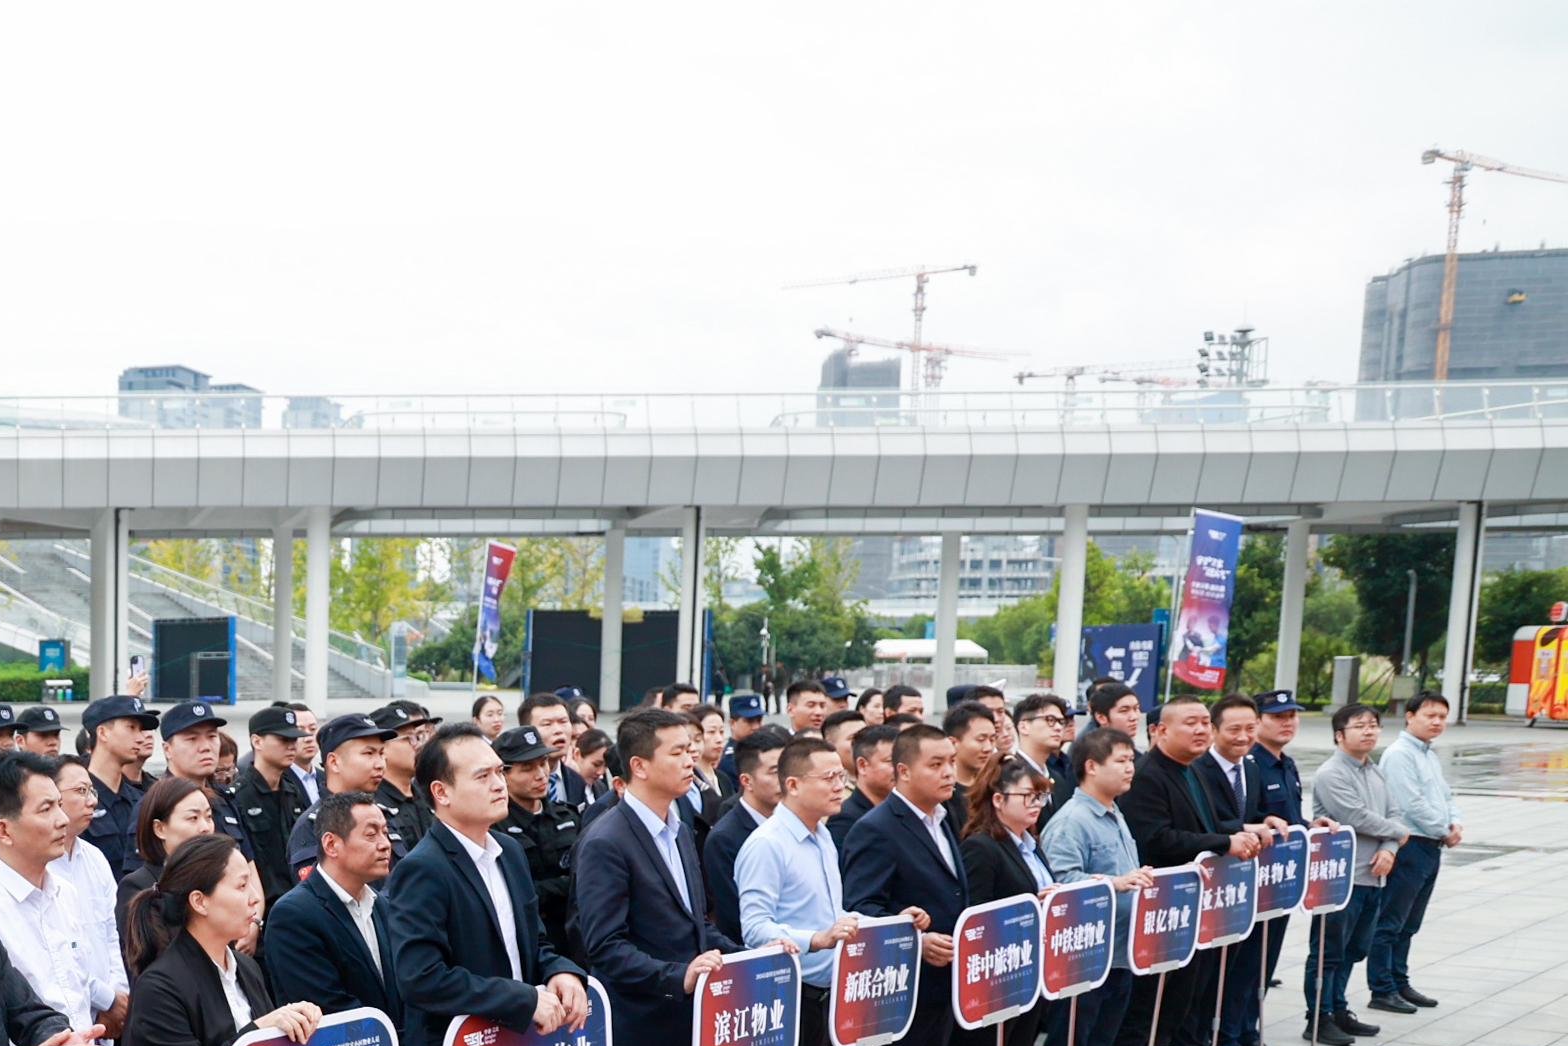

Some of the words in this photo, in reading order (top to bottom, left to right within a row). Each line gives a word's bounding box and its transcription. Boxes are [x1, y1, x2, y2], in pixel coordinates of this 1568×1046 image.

[1258, 859, 1298, 888] 科物业
[1050, 920, 1106, 957] 中铁建物业
[1143, 904, 1192, 935] 银亿物业
[966, 939, 1033, 985] 港中旅物业
[844, 963, 910, 1004] 新联合物业
[714, 998, 785, 1046] 滨江物业
